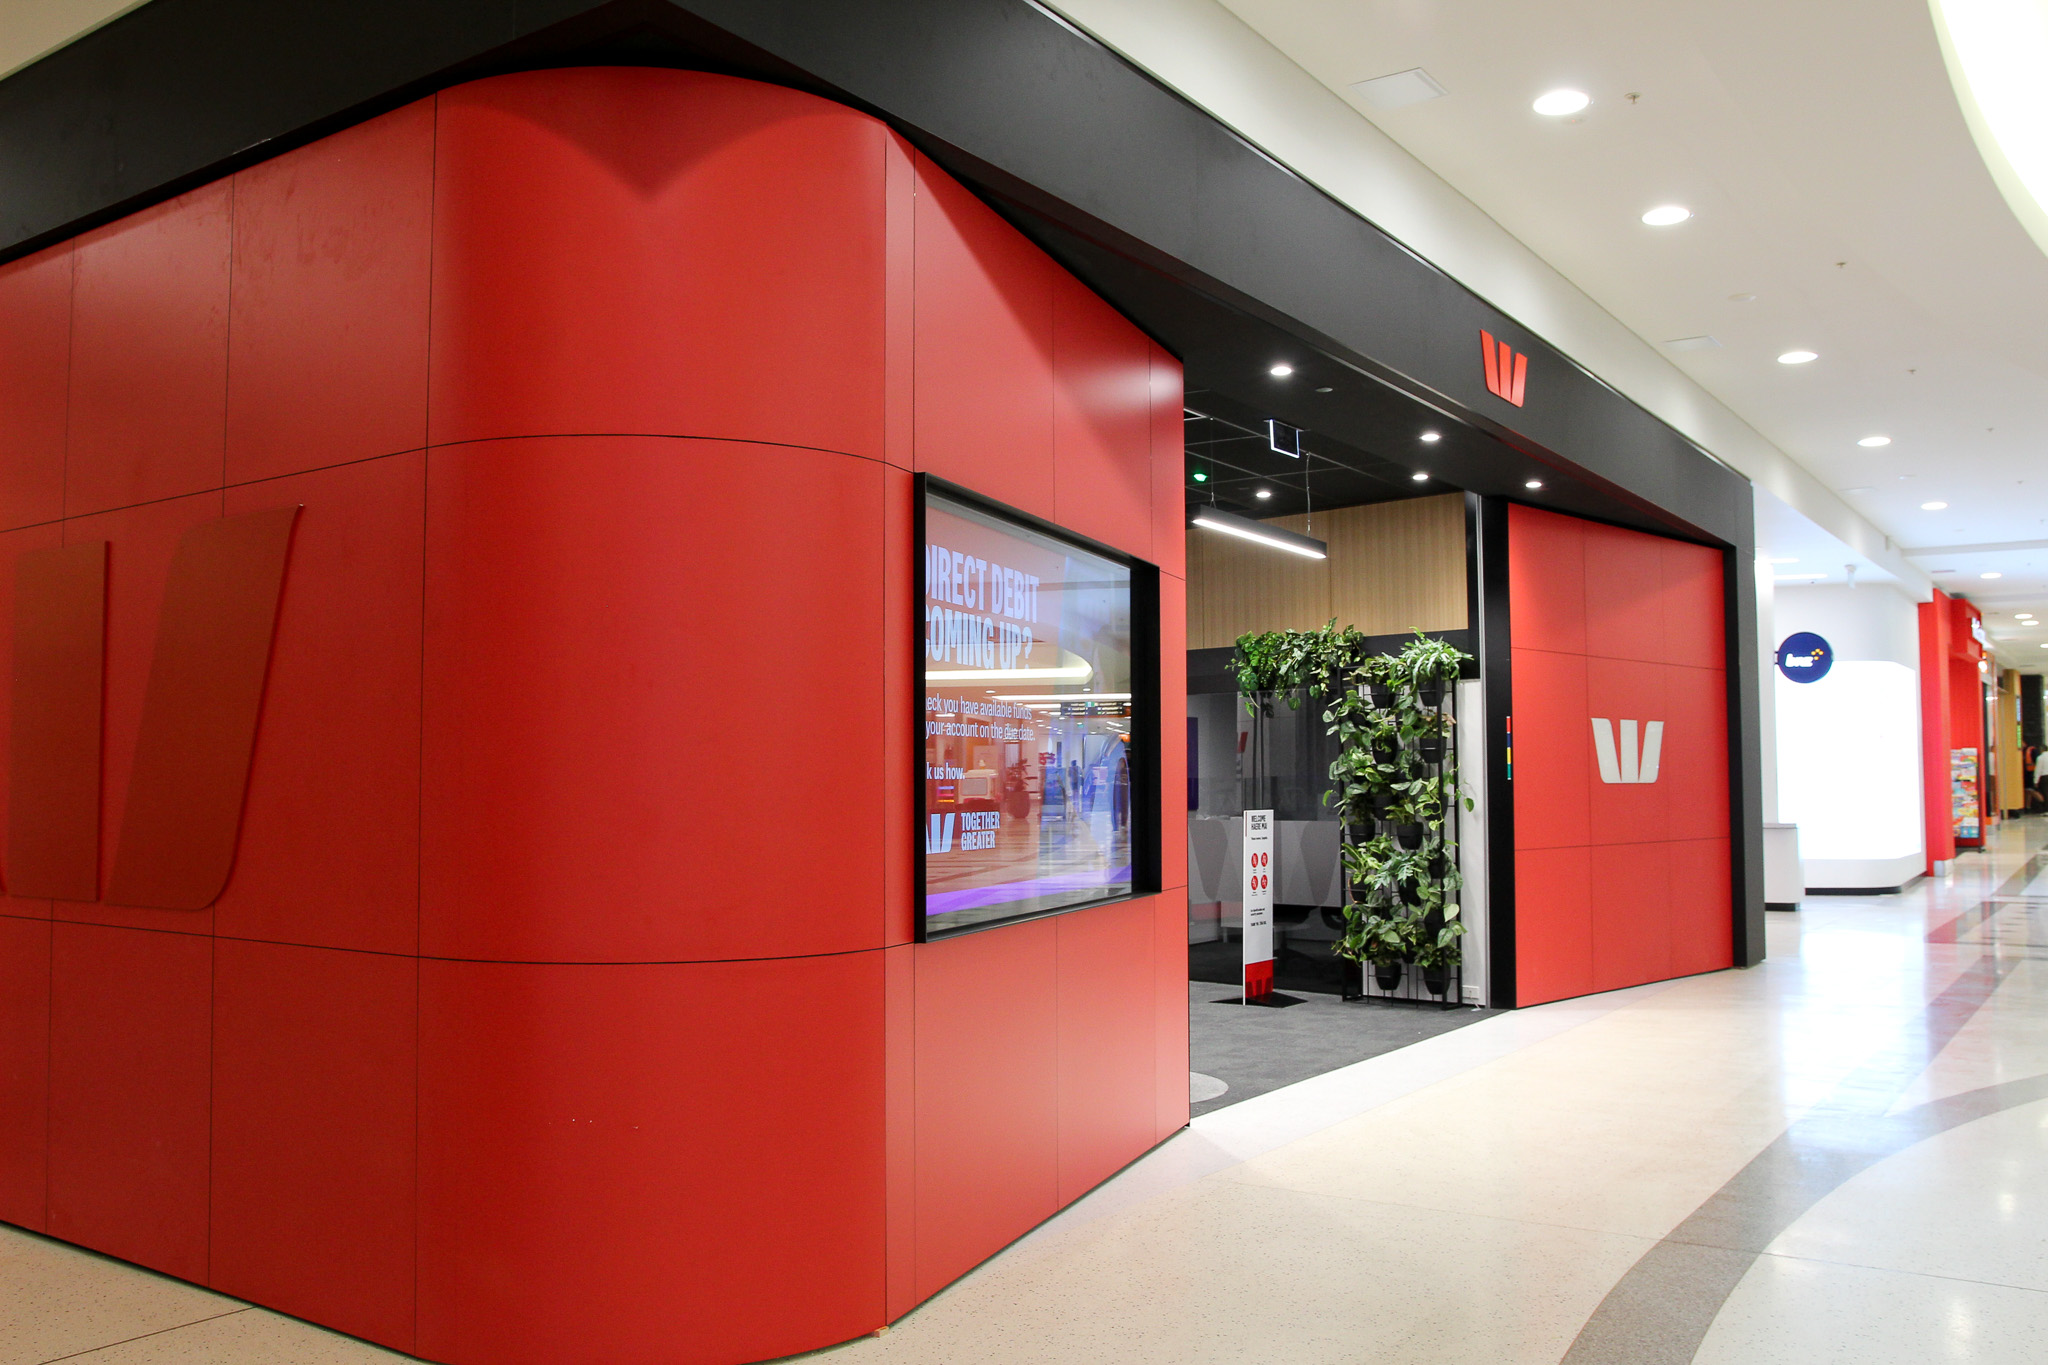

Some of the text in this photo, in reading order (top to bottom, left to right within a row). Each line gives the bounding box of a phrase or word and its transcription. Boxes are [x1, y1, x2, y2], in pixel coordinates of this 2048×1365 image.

[991, 563, 1040, 624] DEBIT
[1000, 621, 1033, 671] UP?
[926, 692, 1032, 720] eck you have available funds
[925, 720, 1036, 741] your account on the due date.
[934, 766, 945, 780] us
[945, 762, 966, 780] how.
[960, 811, 1000, 831] TOGETHER
[961, 830, 996, 851] GREATER
